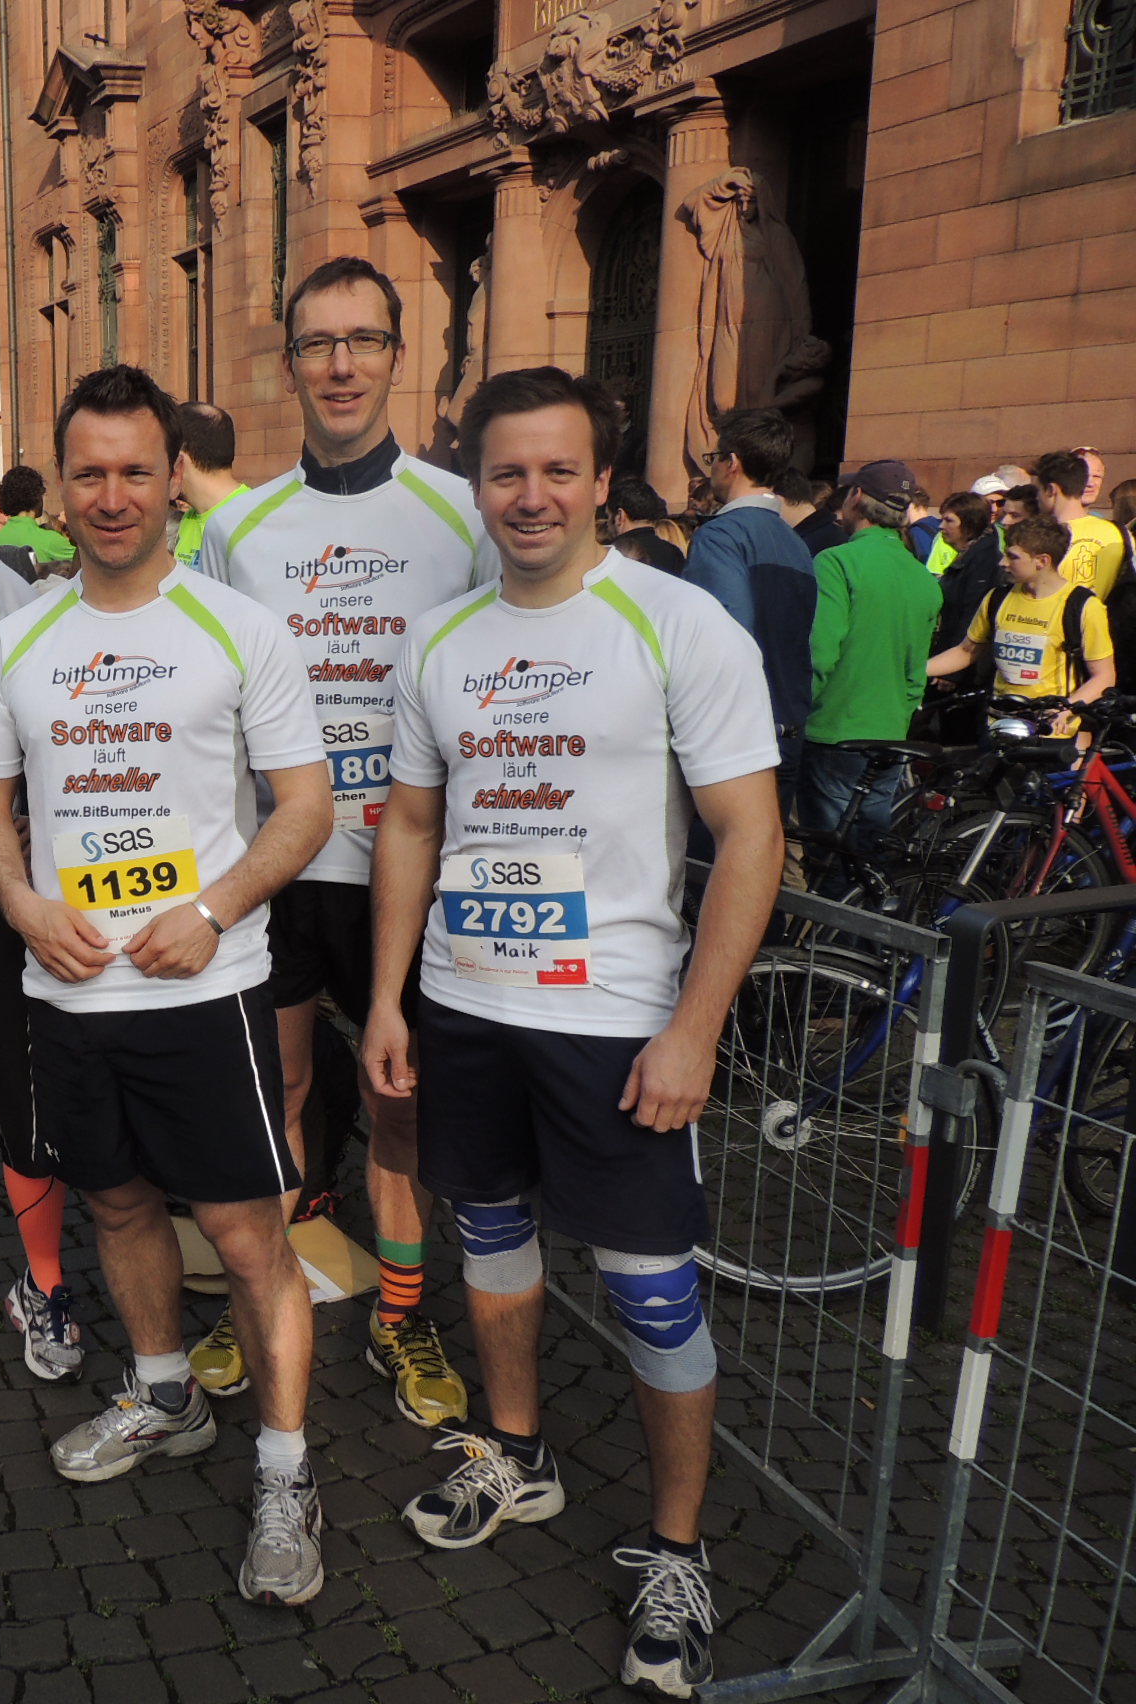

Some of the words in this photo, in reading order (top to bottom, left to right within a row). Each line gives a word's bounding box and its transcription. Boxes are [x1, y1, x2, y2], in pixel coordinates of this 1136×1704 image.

[285, 558, 409, 580] bitbumper
[319, 595, 373, 608] unsere
[287, 612, 406, 637] Software
[327, 640, 360, 654] läuft
[998, 646, 1036, 663] 3045
[52, 664, 178, 685] bitbumper
[306, 659, 393, 683] chneller
[463, 668, 594, 694] bitbumper
[84, 701, 138, 715] unsere
[315, 694, 395, 708] BitBumper.d
[493, 710, 549, 725] unsere
[51, 719, 172, 746] Software
[322, 722, 369, 744] sas
[458, 730, 586, 758] Software
[94, 749, 126, 763] läuft
[503, 762, 537, 778] läuft
[62, 767, 161, 794] schneller
[334, 791, 366, 802] chen
[472, 783, 575, 810] schneller
[54, 805, 171, 819] www.BitBumper.de
[369, 806, 384, 816] HP
[103, 827, 154, 854] sas
[463, 823, 587, 839] www.BitBumper.de
[78, 861, 178, 903] 1139
[491, 861, 541, 885] sas
[109, 905, 152, 919] Markus
[460, 899, 566, 934] 2792
[494, 941, 540, 959] Maik
